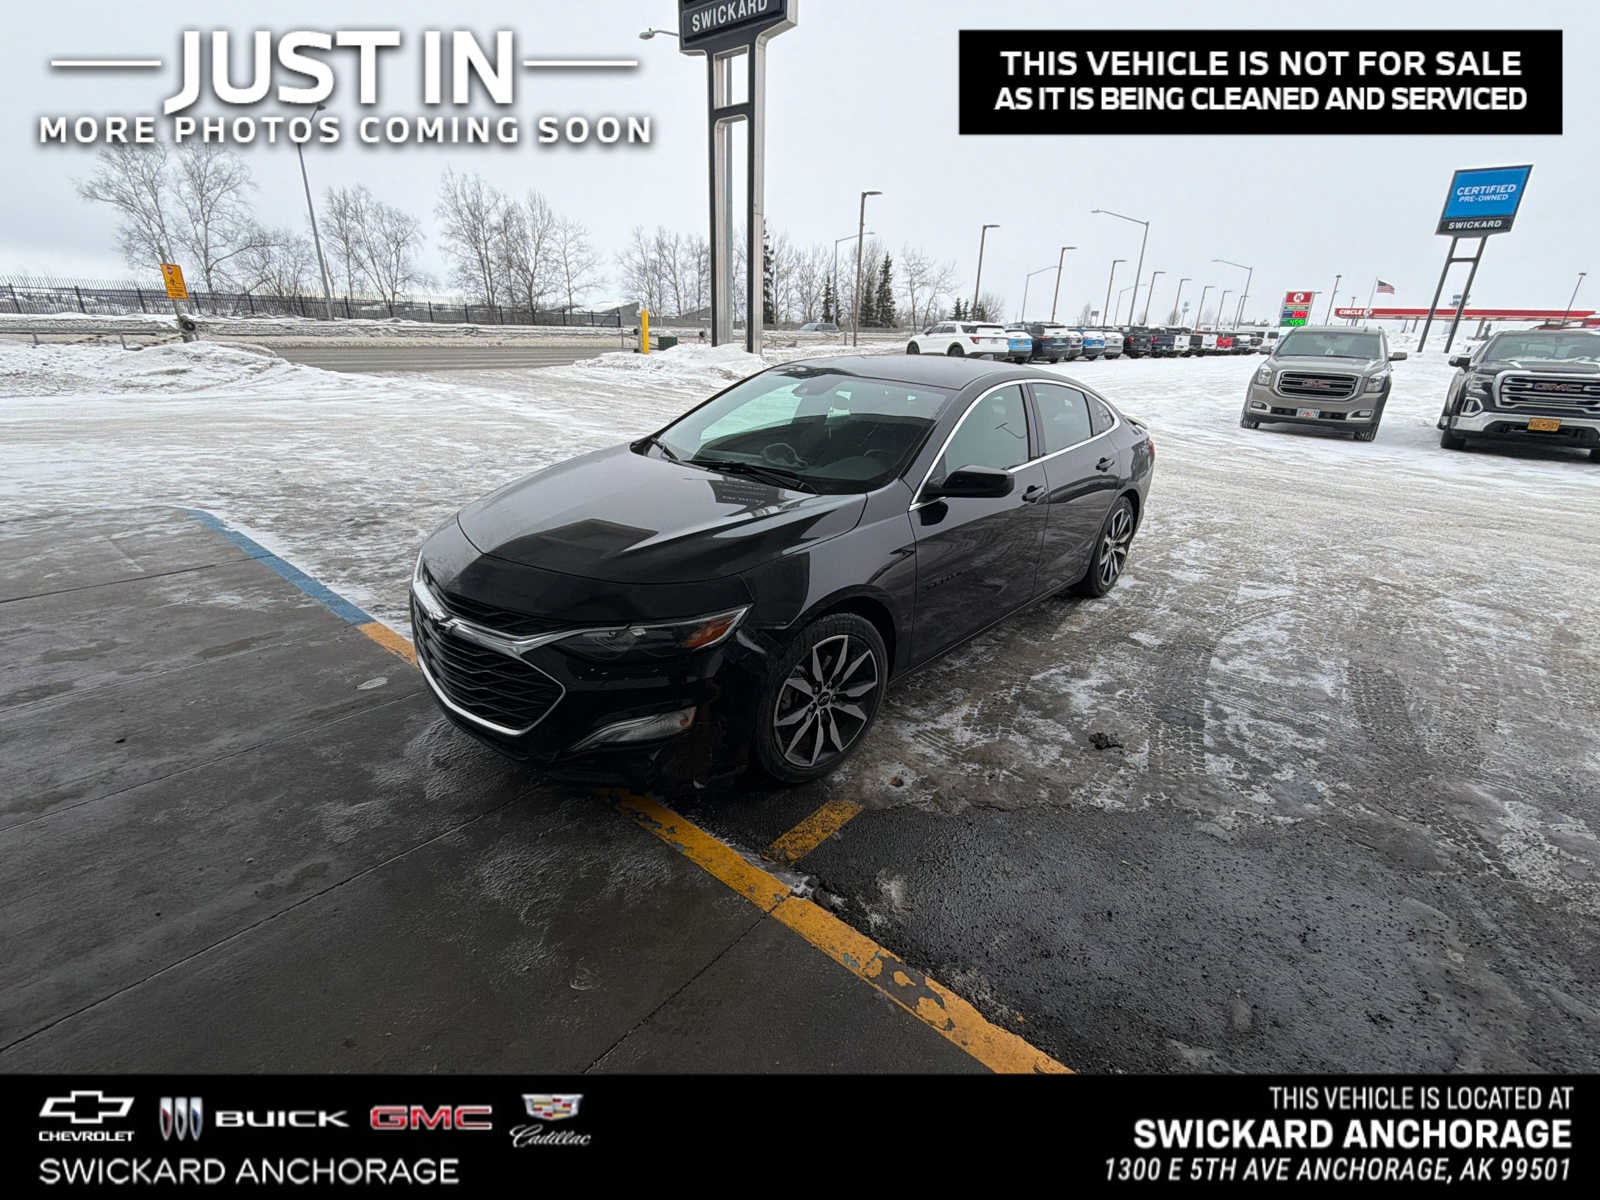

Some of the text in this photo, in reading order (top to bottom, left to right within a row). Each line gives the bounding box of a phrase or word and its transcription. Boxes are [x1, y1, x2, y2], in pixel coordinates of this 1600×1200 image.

[692, 0, 768, 32] SWICKARD
[1457, 184, 1517, 196] CERTIFIED
[1458, 194, 1509, 203] PRE-OWNED
[1448, 220, 1502, 230] SWICKARD
